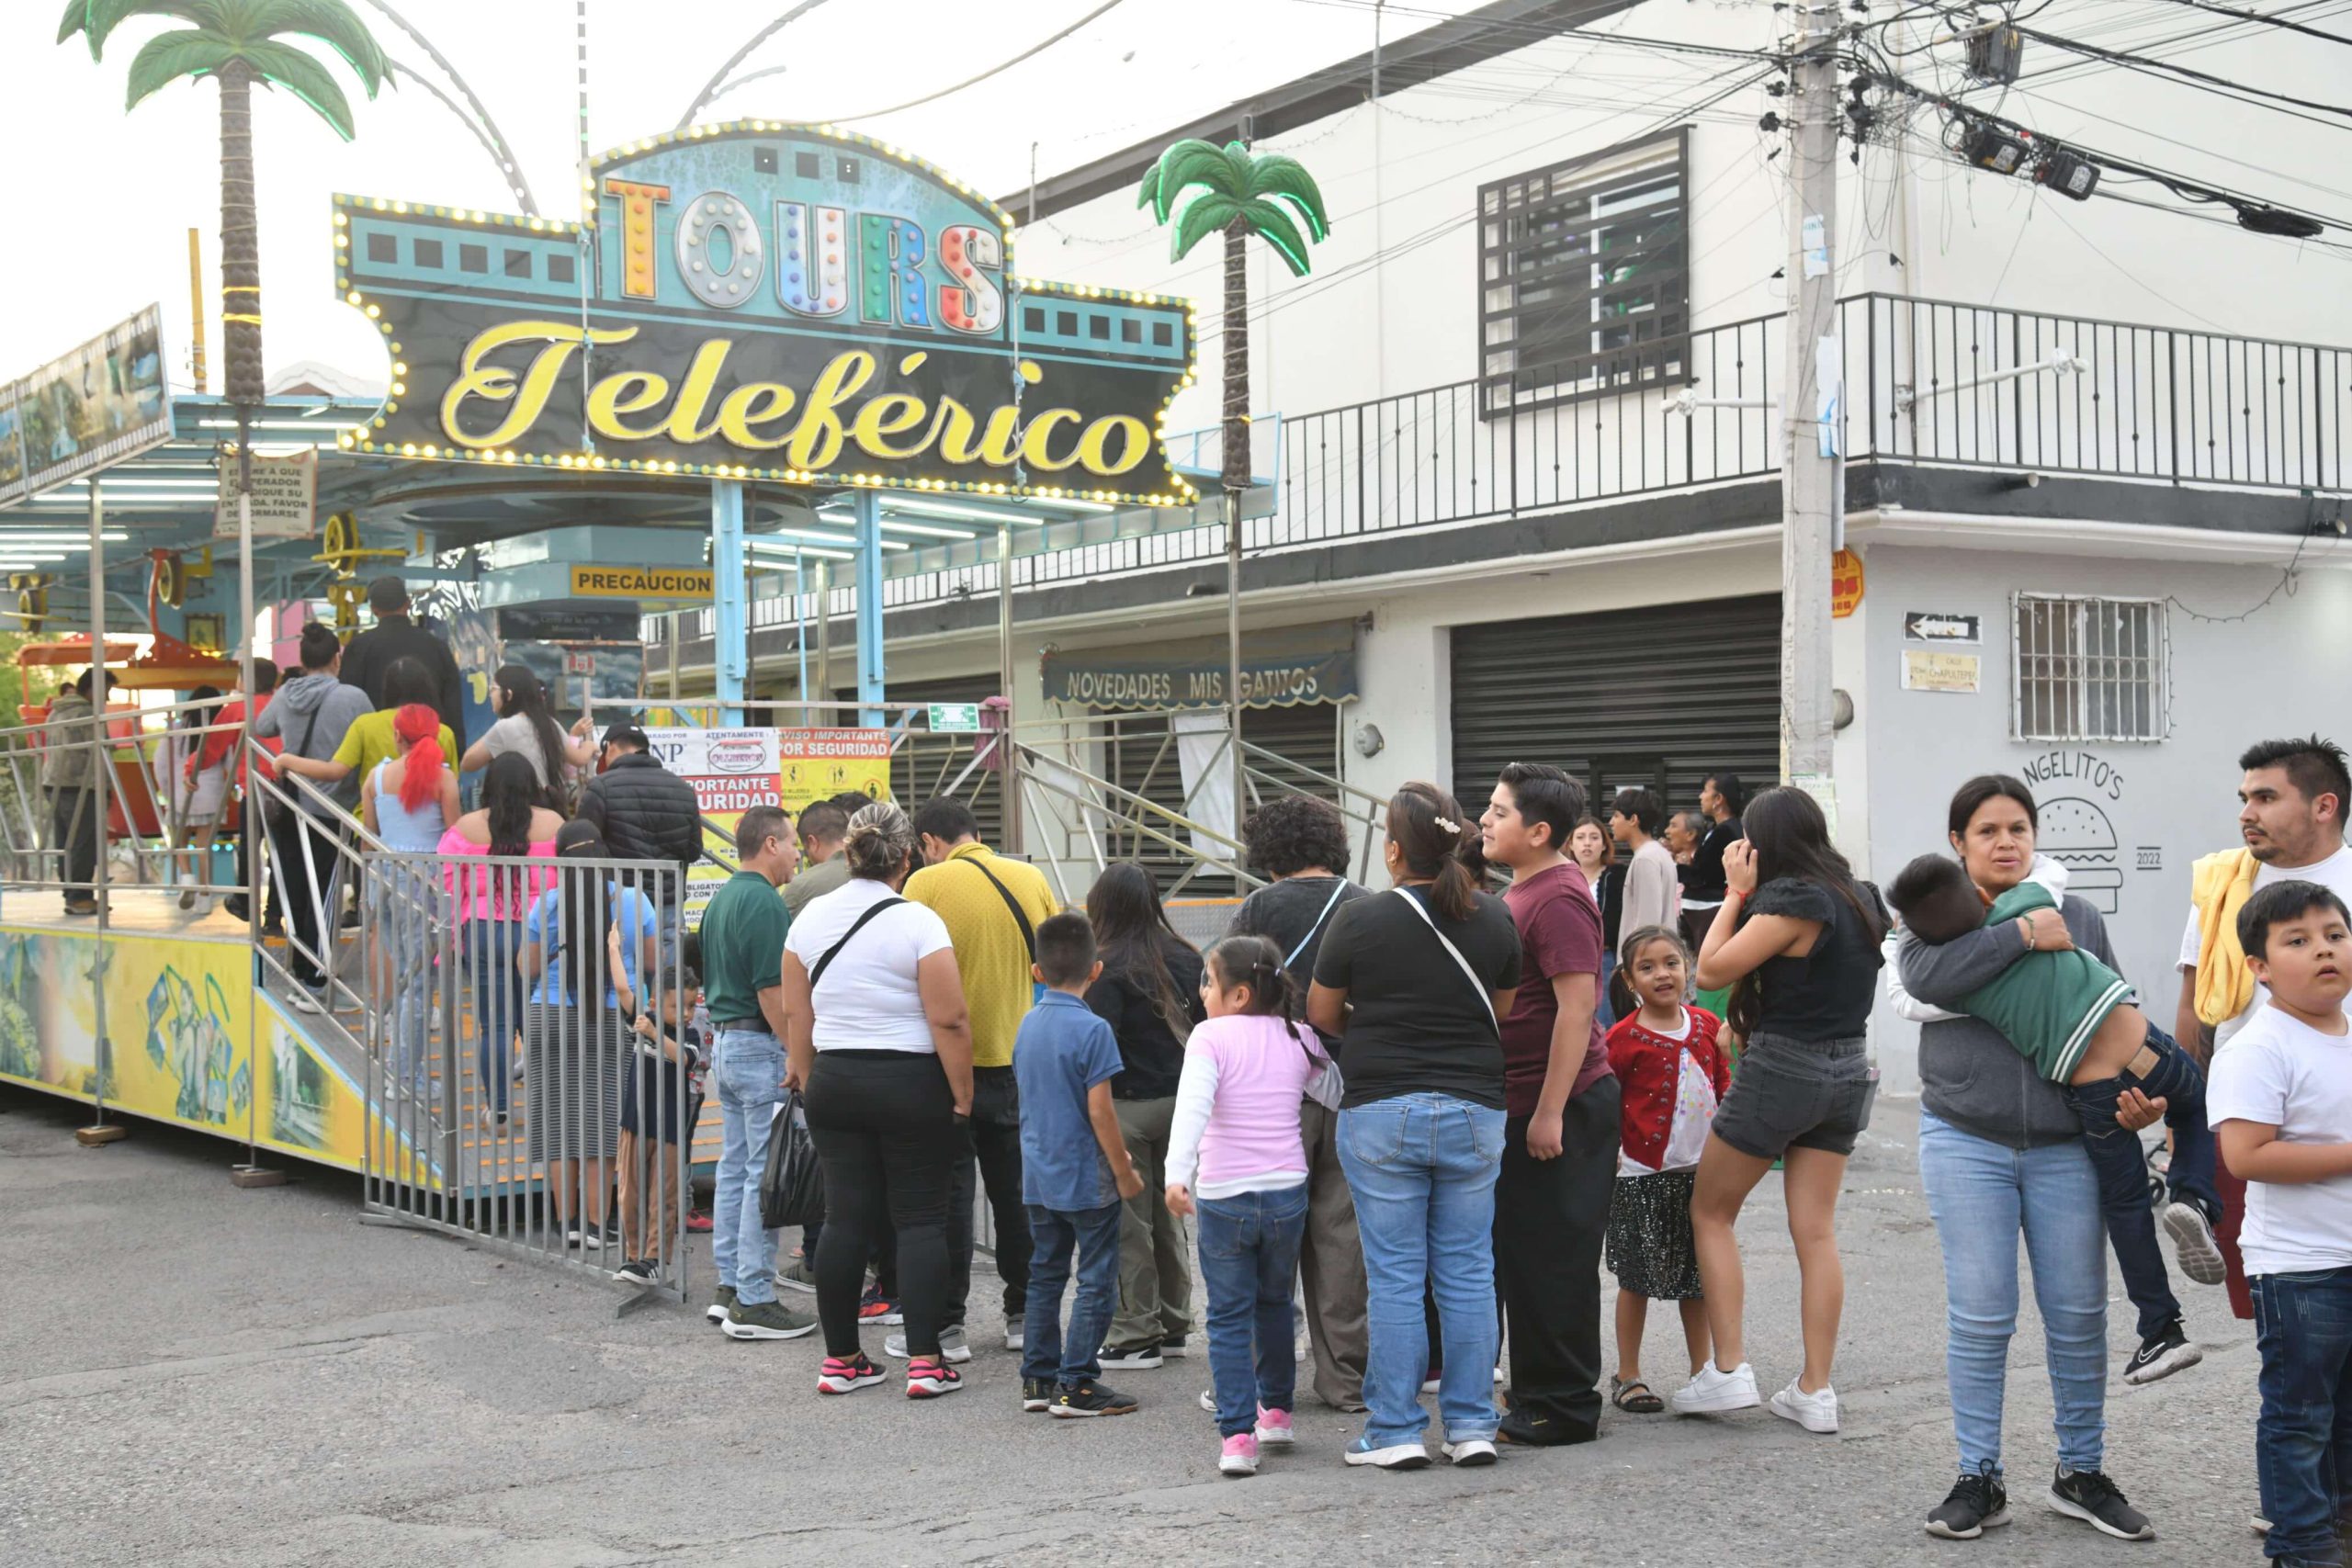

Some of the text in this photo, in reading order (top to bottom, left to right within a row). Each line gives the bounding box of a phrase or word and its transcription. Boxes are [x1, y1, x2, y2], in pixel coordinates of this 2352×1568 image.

[604, 177, 1003, 335] TOURS
[440, 320, 1151, 476] Teleférico
[279, 468, 302, 477] QUE
[249, 478, 301, 487] PERADOR
[287, 490, 302, 498] SU
[273, 499, 309, 509] FAVOR
[250, 509, 300, 519] ORMARSE
[578, 572, 711, 592] PRECAUCION
[1067, 666, 1317, 700] NOVEDADES MIS GATITOS
[706, 731, 764, 739] ATENTAMENTE
[814, 731, 887, 741] IMPORTANTE
[650, 743, 684, 763] NP
[808, 742, 888, 756] SEGURIDAD
[2022, 750, 2124, 801] NGELITO'S
[684, 777, 770, 792] PORTANTE
[696, 792, 780, 811] URIDAD
[2136, 852, 2161, 865] 2022
[686, 883, 724, 891] BLIGATO
